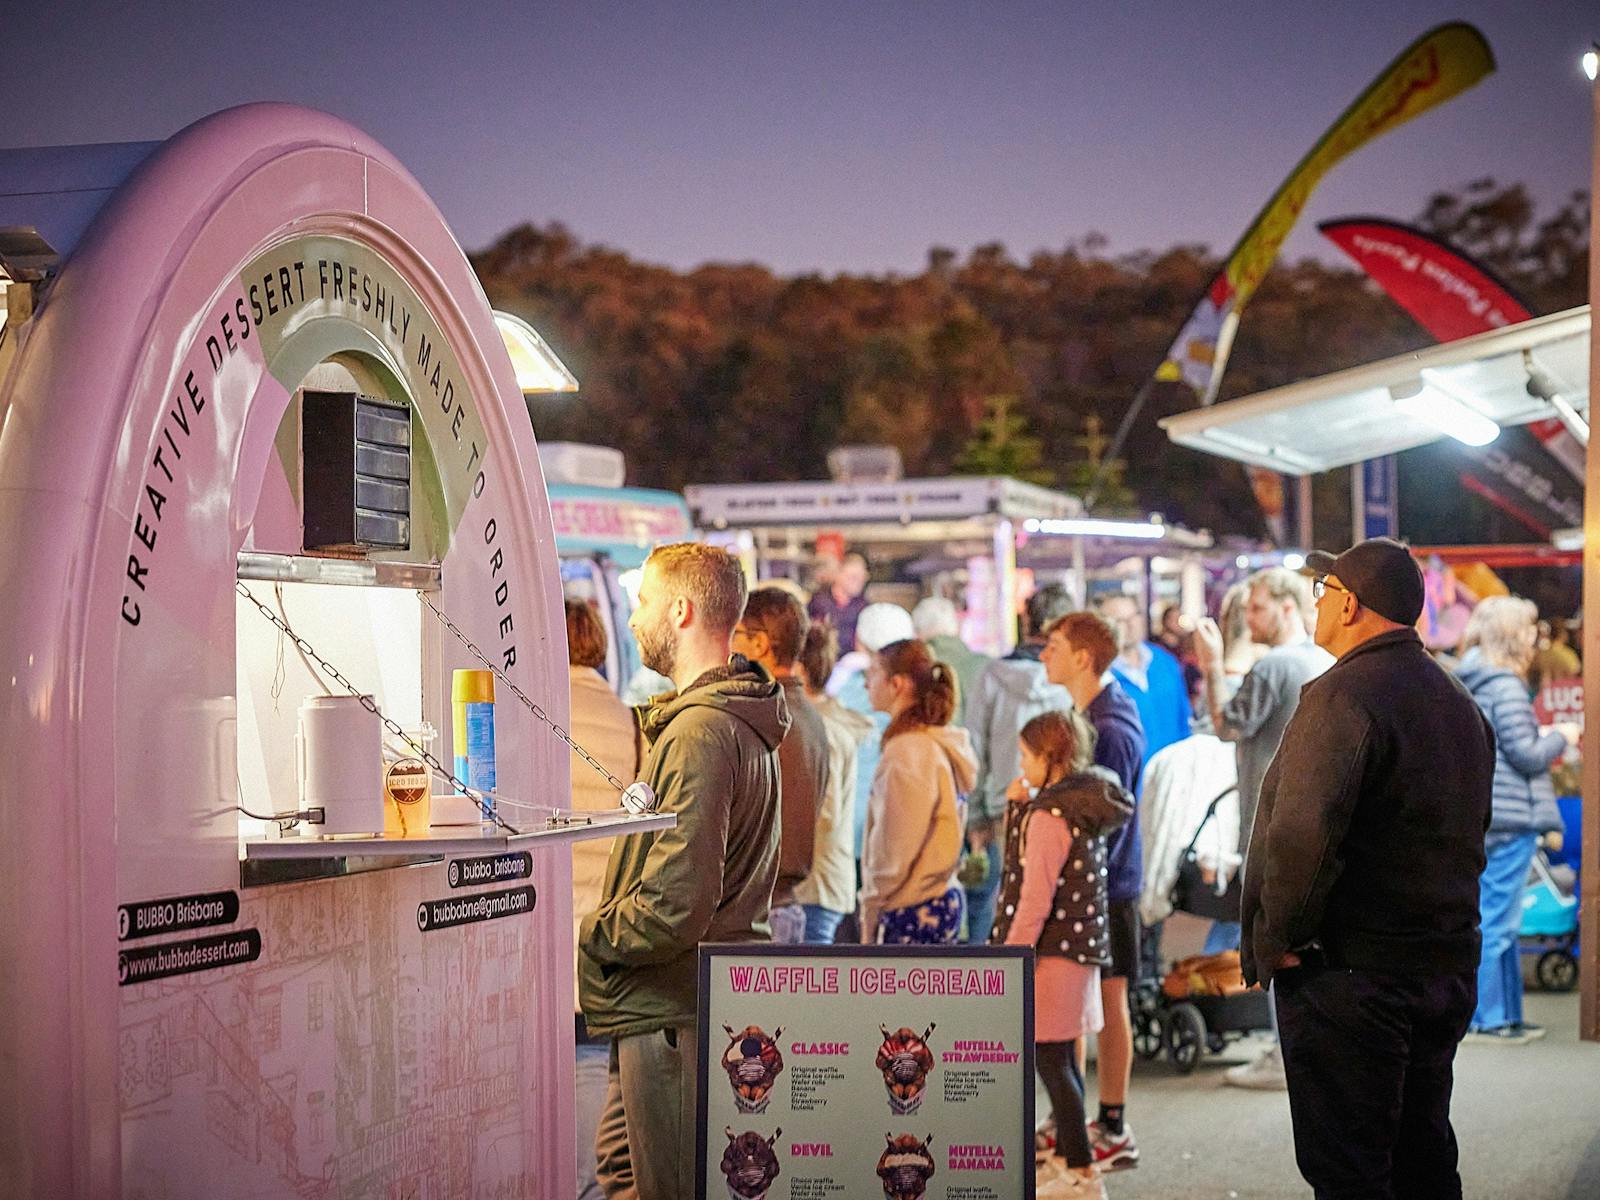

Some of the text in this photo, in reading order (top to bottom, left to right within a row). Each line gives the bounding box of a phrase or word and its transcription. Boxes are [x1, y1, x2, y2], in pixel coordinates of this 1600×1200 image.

[121, 260, 517, 672] CREATIVE DESSERT FRESHLY MADE TO ORDER
[463, 858, 525, 879] bubbo_brisbane
[433, 892, 528, 923] bubbobne@gmail.com
[136, 900, 224, 930] BUBBO Brisbane
[129, 939, 250, 977] www.bubbodessert.com
[729, 966, 1005, 995] WAFFLE ICE-CREAM
[791, 1042, 849, 1055] CLASSIC
[954, 1040, 1005, 1051] NUTELLA
[942, 1052, 1019, 1063] STRAWBERRY
[791, 1097, 827, 1106] Strawberry
[791, 1144, 833, 1157] DEVIL
[948, 1144, 1005, 1157] NUTELLA
[948, 1159, 1005, 1169] BANANA
